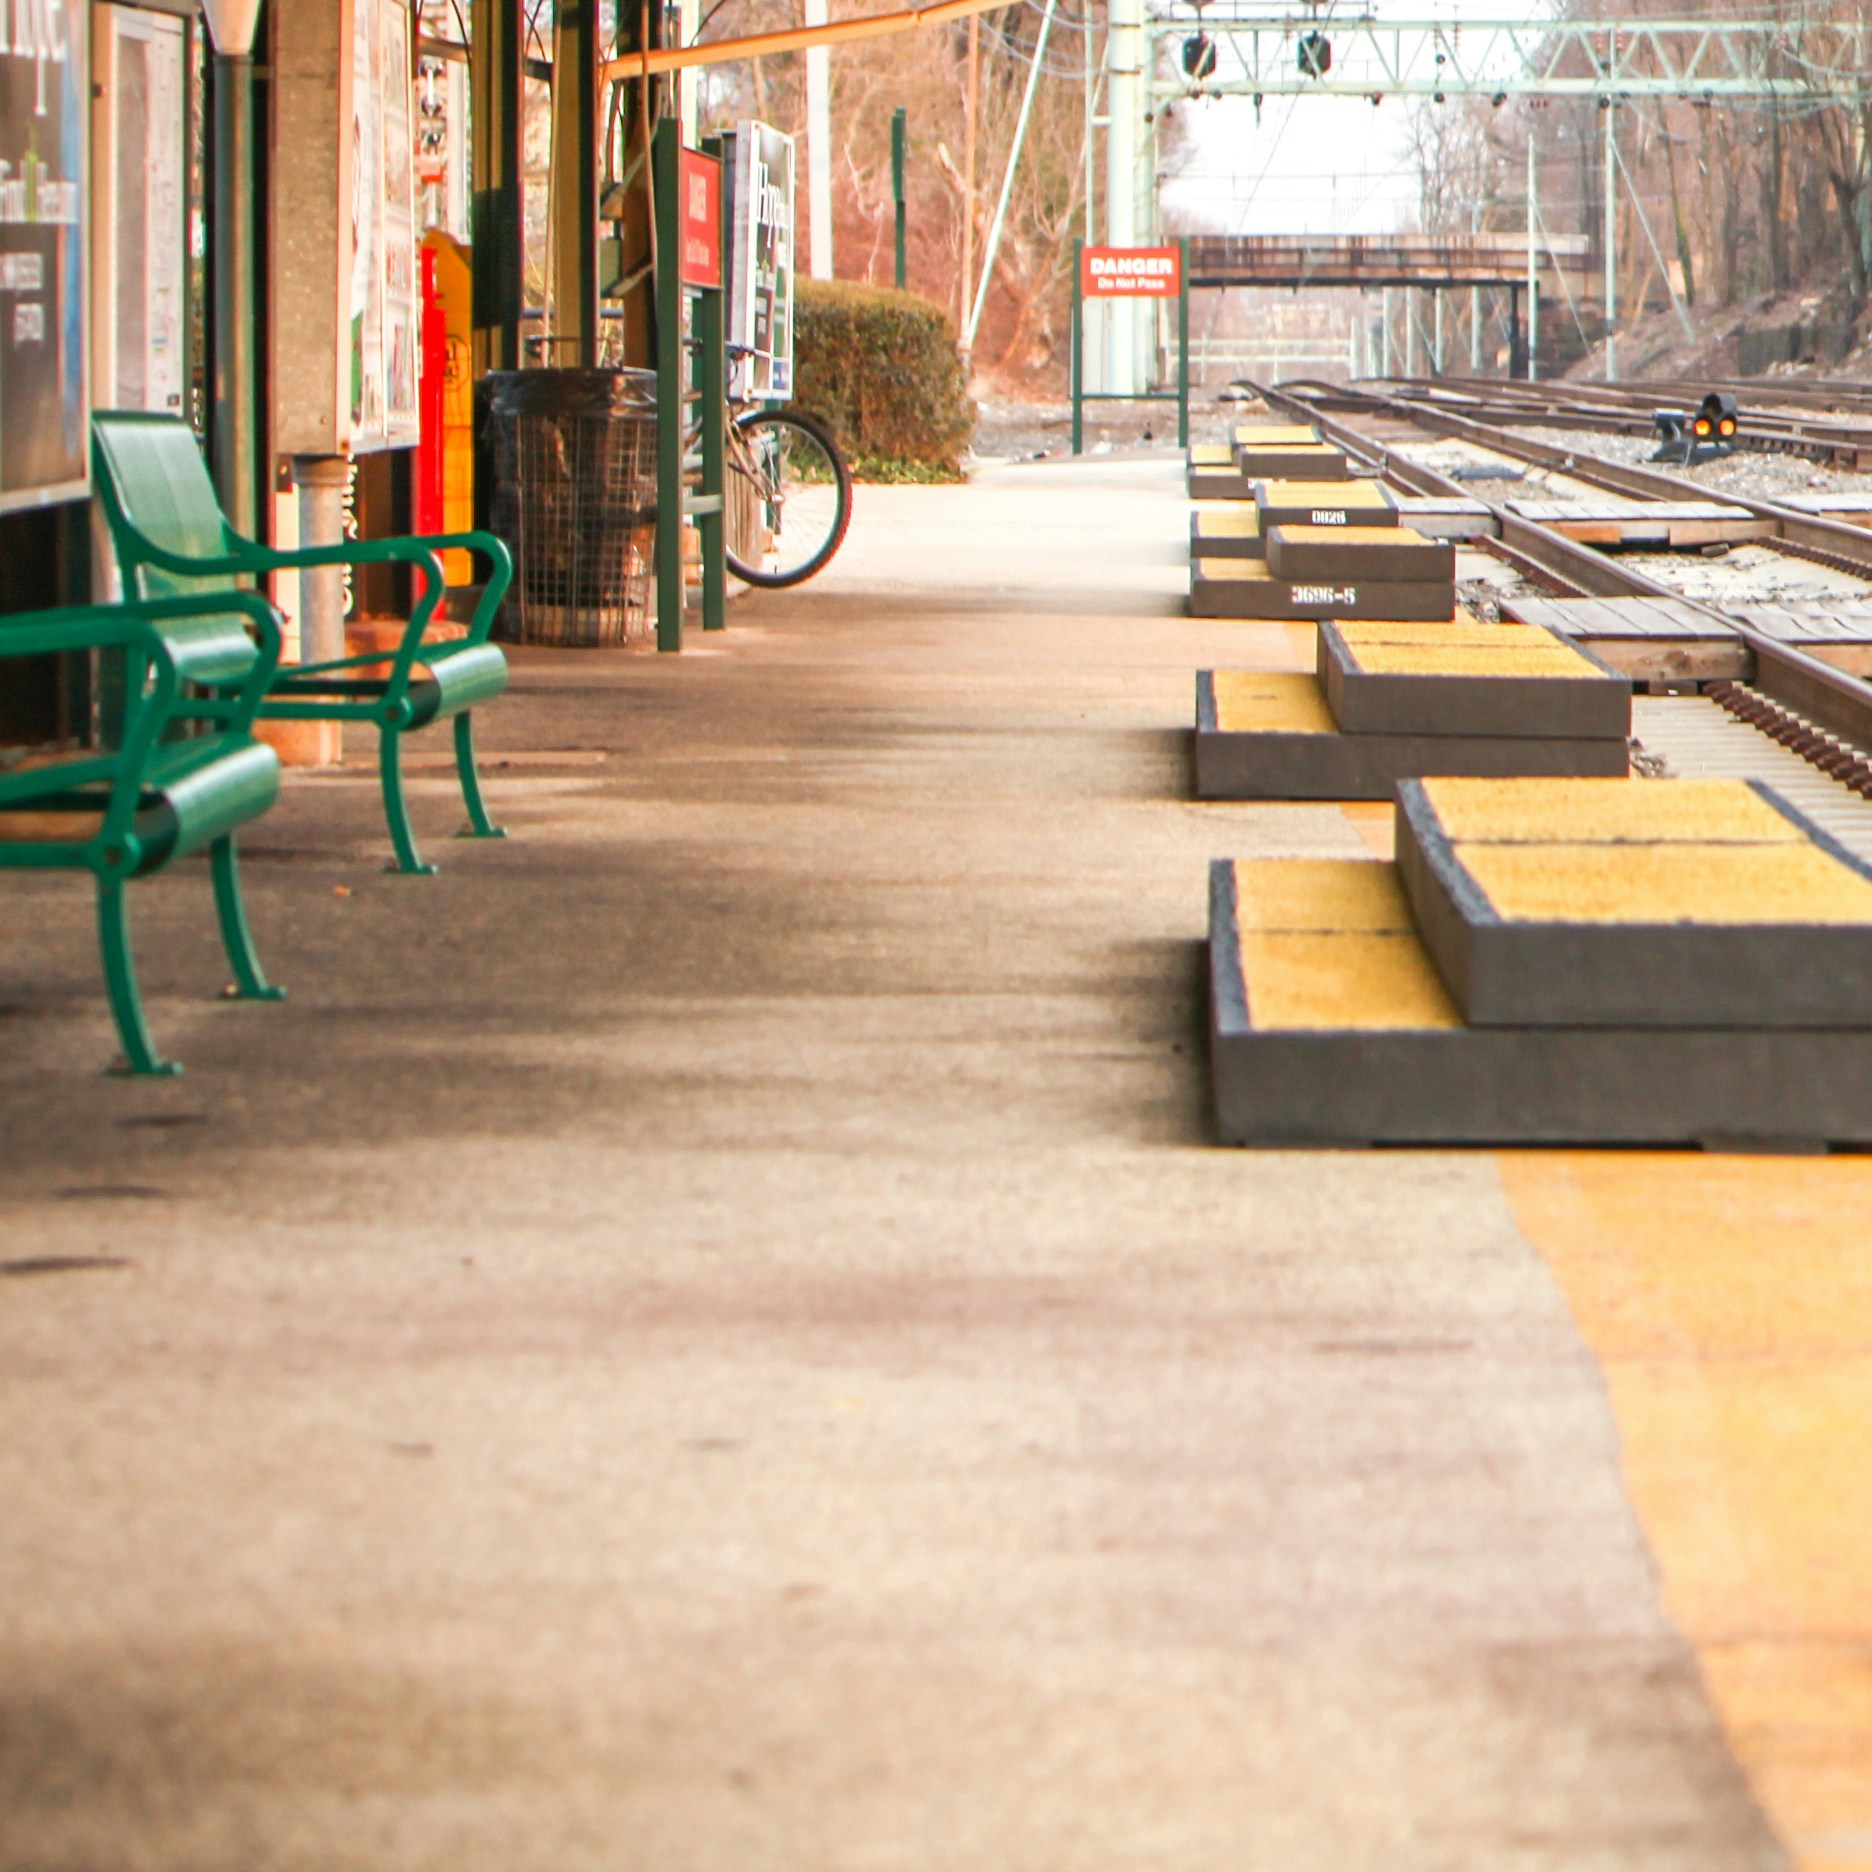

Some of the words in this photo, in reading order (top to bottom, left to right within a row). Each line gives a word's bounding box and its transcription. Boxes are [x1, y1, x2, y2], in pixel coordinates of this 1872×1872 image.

[1089, 257, 1173, 275] DANGER
[1097, 277, 1114, 289] Do
[1115, 277, 1136, 289] Not
[1137, 277, 1165, 289] Pass
